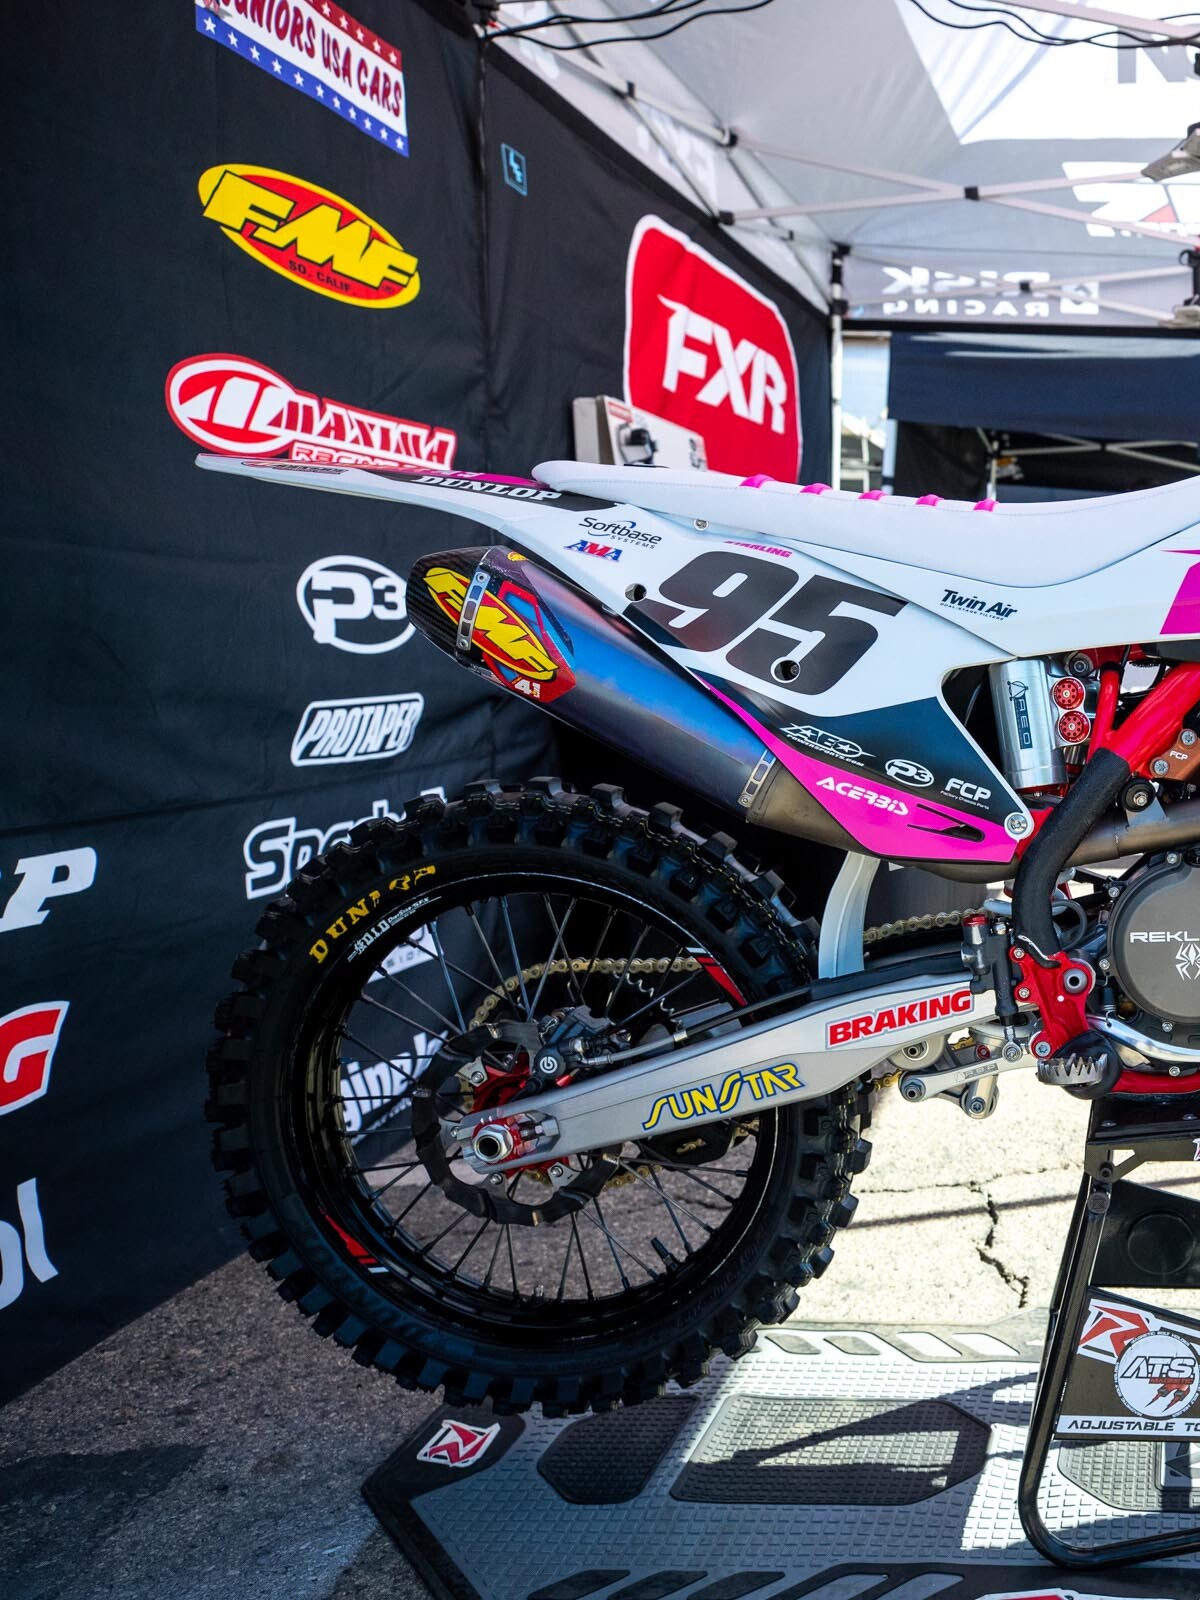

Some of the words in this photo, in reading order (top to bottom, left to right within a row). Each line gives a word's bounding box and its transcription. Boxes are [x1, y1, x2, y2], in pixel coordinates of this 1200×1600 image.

[320, 28, 352, 88] USA
[357, 57, 402, 118] CARS
[203, 171, 418, 288] FMF
[657, 294, 788, 435] FXR
[411, 475, 562, 501] DUNLOP
[564, 539, 624, 563] AMA
[578, 516, 663, 546] Softbase
[611, 534, 656, 550] SYSTEMS
[311, 571, 407, 644] P3
[422, 571, 560, 673] FMF
[623, 551, 911, 696] 95
[941, 589, 986, 612] Twin
[986, 601, 1019, 618] Air
[309, 699, 422, 758] PROTAPER
[816, 776, 910, 817] ACERBIS
[887, 760, 932, 784] P3
[944, 777, 992, 801] FCP
[827, 989, 973, 1047] BRAKING
[641, 1062, 804, 1131] SUNSTAR
[1067, 1421, 1176, 1433] ADJUSTABLE
